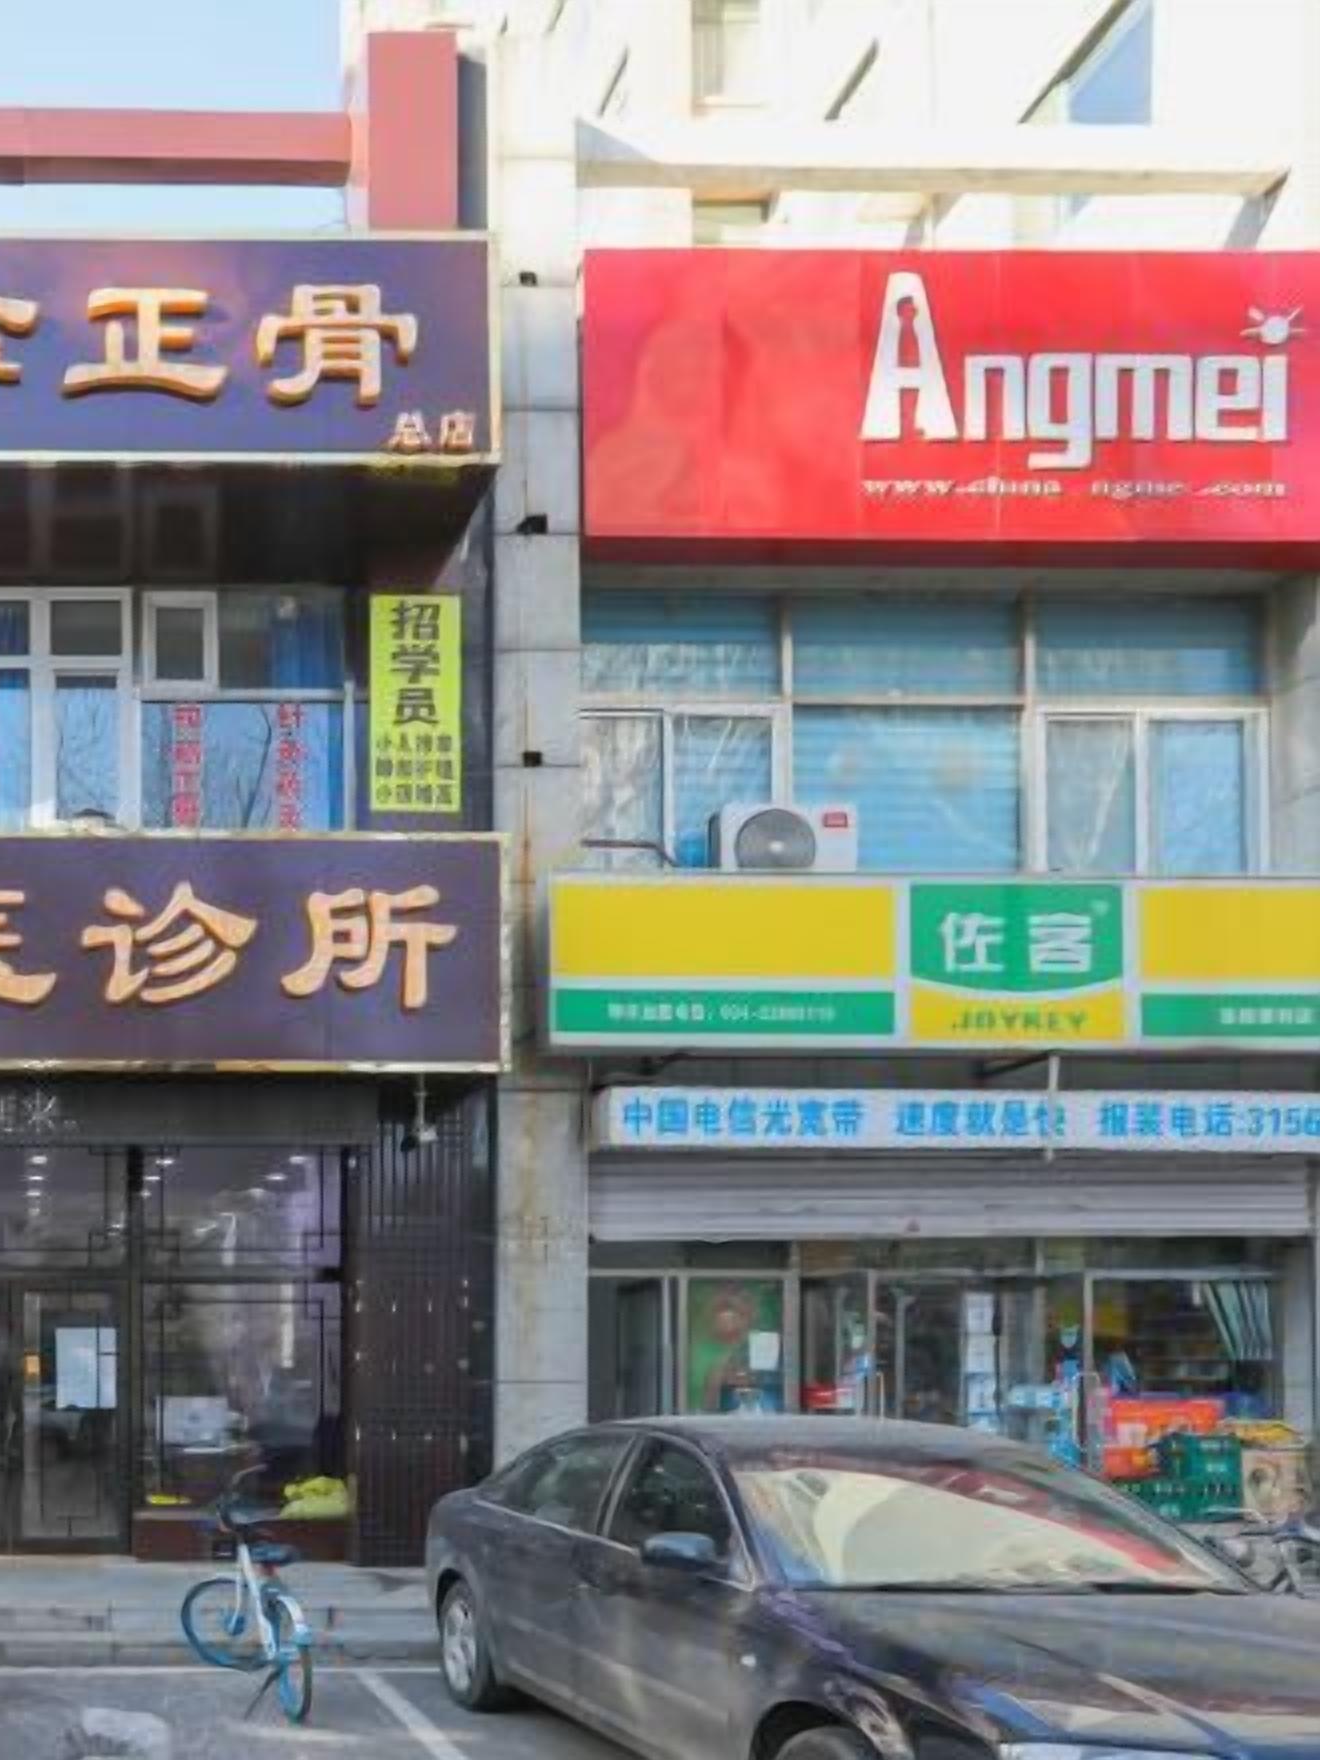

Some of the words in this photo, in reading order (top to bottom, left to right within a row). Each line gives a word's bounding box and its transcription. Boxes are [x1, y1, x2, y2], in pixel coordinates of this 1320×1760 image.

[859, 271, 1305, 469] Angmei
[388, 411, 477, 450] 总店
[389, 599, 441, 725] 招学员
[939, 911, 1093, 973] 佐客
[622, 1098, 867, 1138] 中国电信光宽带
[895, 1100, 1067, 1138] 速度就是快
